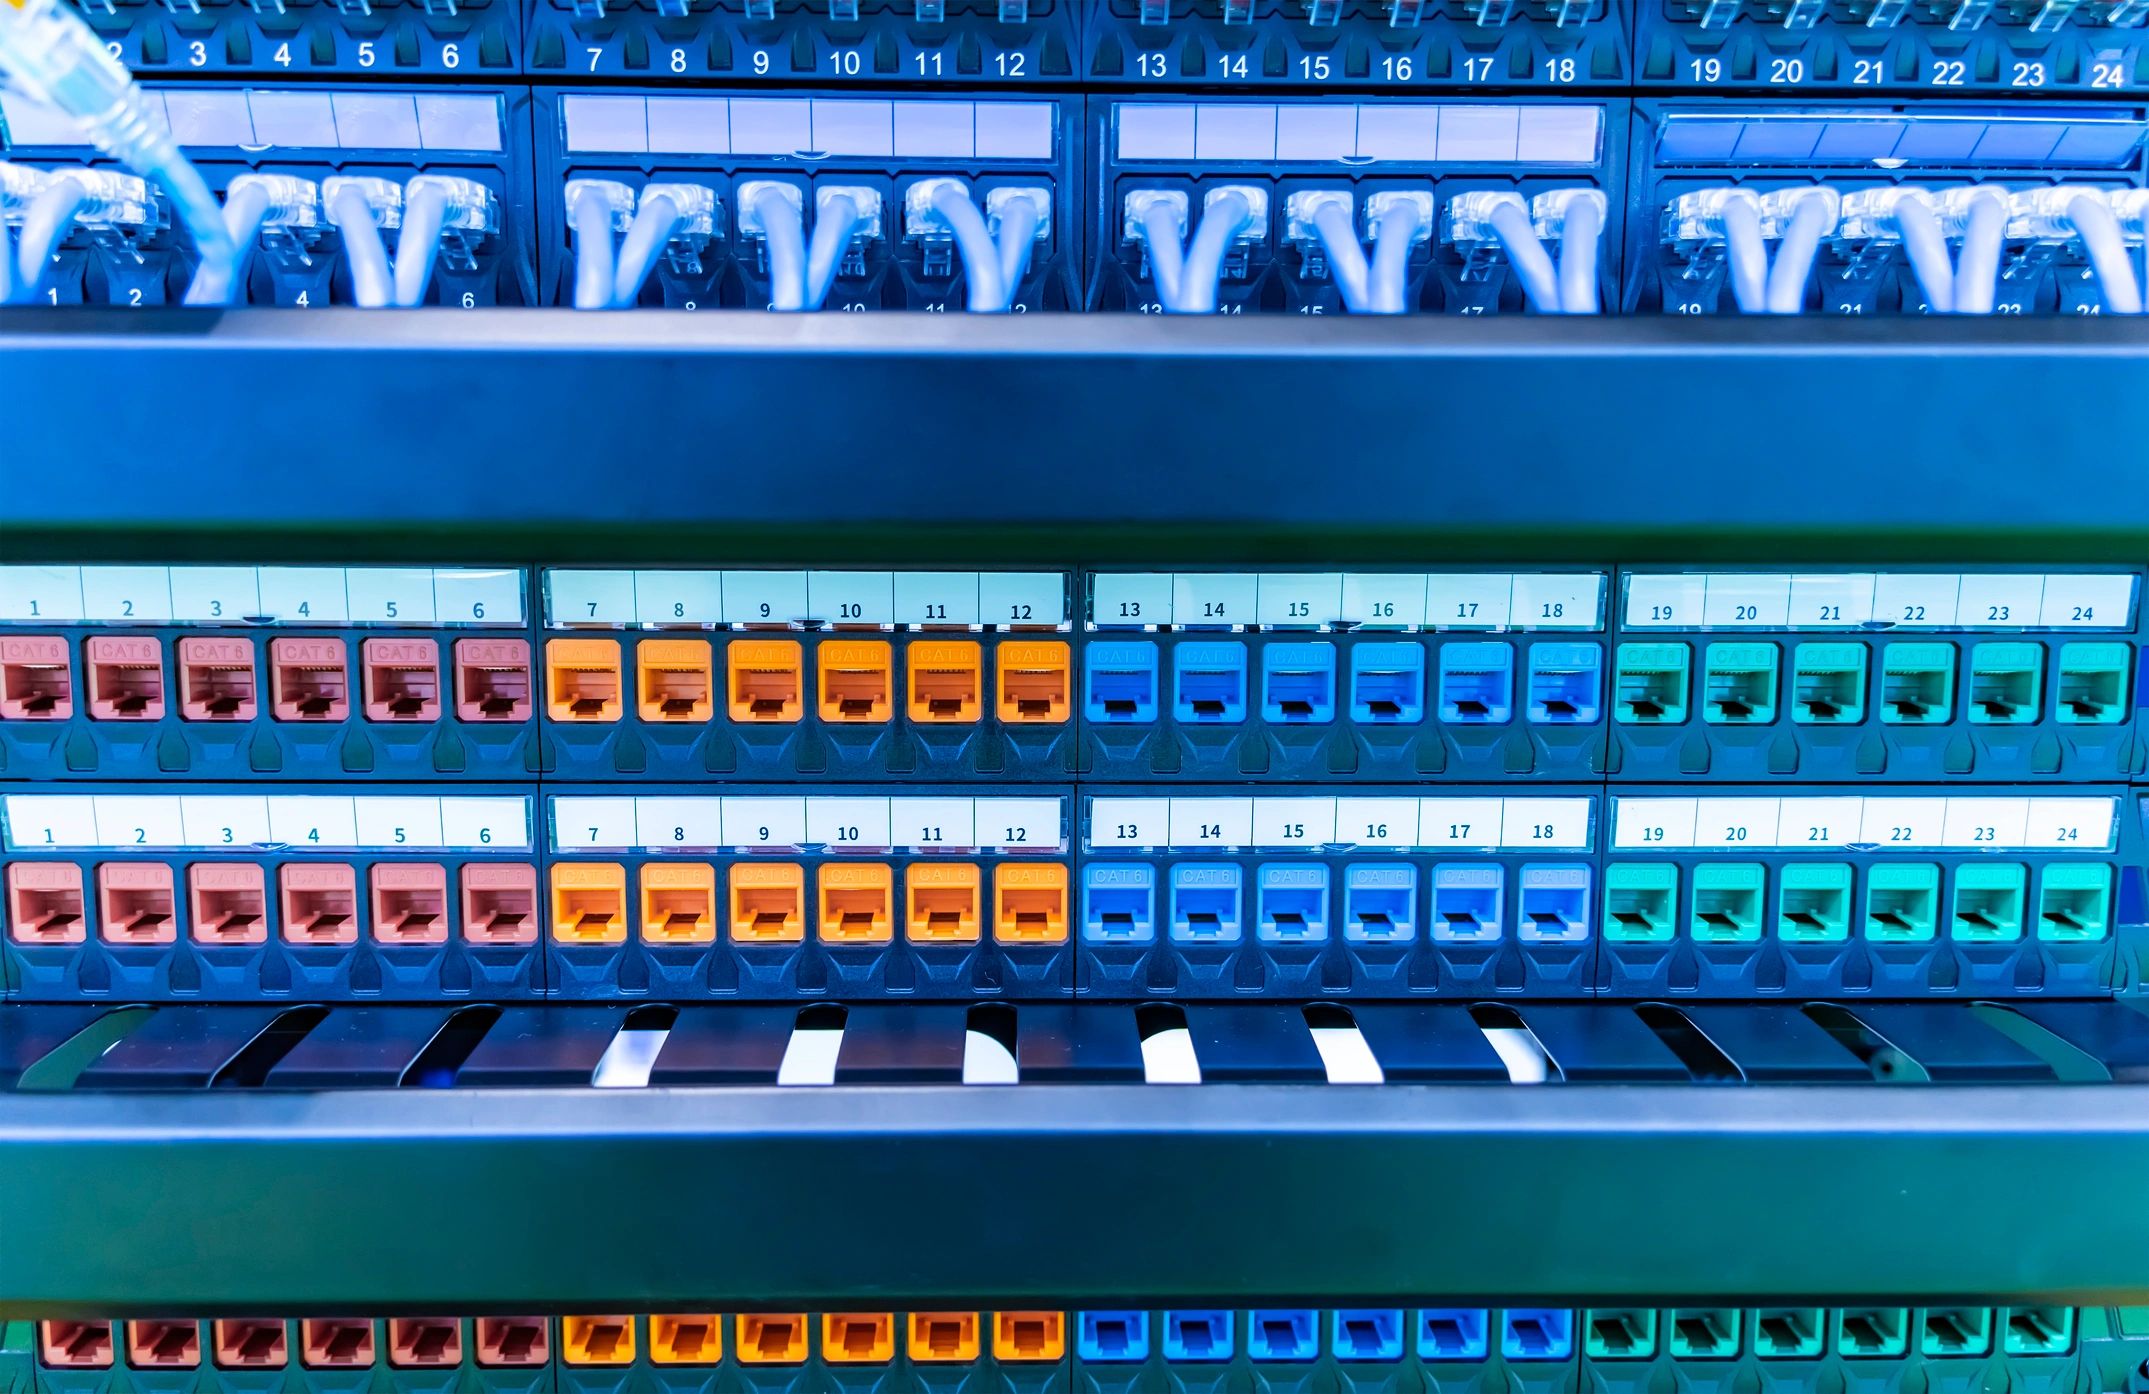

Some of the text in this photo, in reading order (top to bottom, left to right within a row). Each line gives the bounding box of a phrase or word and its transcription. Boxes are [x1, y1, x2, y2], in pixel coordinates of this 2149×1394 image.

[106, 41, 123, 66] 2
[190, 40, 207, 67] 3
[273, 42, 292, 67] 4
[358, 42, 375, 67] 5
[442, 43, 460, 69] 6
[587, 47, 603, 72] 7
[670, 48, 687, 73] 8
[753, 50, 769, 75] 9
[830, 50, 861, 75] 10
[915, 52, 942, 76] 11
[995, 52, 1025, 77] 12
[1136, 53, 1167, 78] 13
[1218, 54, 1249, 79] 14
[1299, 55, 1330, 80] 15
[1382, 56, 1412, 81] 16
[1463, 57, 1494, 82] 17
[1545, 58, 1575, 83] 18
[1690, 58, 1721, 83] 19
[1770, 59, 1804, 83] 20
[1853, 59, 1883, 84] 21
[1931, 61, 1966, 86] 22
[2011, 62, 2046, 87] 23
[2091, 63, 2125, 88] 24
[48, 288, 58, 306] 1
[128, 288, 142, 306] 2
[296, 291, 309, 307] 4
[462, 292, 475, 309] 6
[30, 599, 41, 616] 1
[122, 600, 134, 617] 2
[210, 600, 222, 617] 3
[298, 601, 310, 618] 4
[386, 601, 398, 618] 5
[472, 602, 485, 619] 6
[587, 602, 597, 617] 7
[674, 602, 684, 618] 8
[760, 602, 771, 618] 9
[840, 603, 862, 619] 10
[925, 604, 947, 619] 11
[1010, 604, 1032, 620] 12
[1119, 602, 1141, 617] 13
[1203, 602, 1225, 617] 14
[1288, 602, 1309, 617] 15
[1372, 602, 1394, 617] 16
[1457, 603, 1479, 618] 17
[1542, 603, 1563, 618] 18
[1651, 605, 1673, 621] 19
[1735, 605, 1757, 620] 20
[1819, 605, 1841, 621] 21
[1903, 606, 1925, 621] 22
[1987, 606, 2009, 621] 23
[2071, 606, 2093, 621] 24
[9, 644, 59, 658] CAT 6
[102, 644, 152, 658] CAT 6
[193, 645, 244, 659] CAT 6
[285, 646, 336, 660] CAT 6
[376, 646, 427, 660] CAT 6
[469, 646, 519, 660] CAT 6
[830, 649, 879, 662] CAT 6
[920, 649, 969, 662] CAT 6
[1009, 649, 1058, 662] CAT 6
[44, 828, 55, 844] 1
[135, 828, 147, 844] 2
[222, 827, 233, 843] 3
[308, 828, 320, 843] 4
[394, 827, 406, 844] 5
[479, 827, 491, 844] 6
[588, 827, 599, 842] 7
[674, 826, 685, 841] 8
[759, 826, 769, 841] 9
[838, 826, 859, 841] 10
[922, 827, 943, 842] 11
[1005, 827, 1027, 842] 12
[1117, 824, 1138, 839] 13
[1200, 824, 1221, 839] 14
[1283, 824, 1304, 838] 15
[1366, 823, 1387, 838] 16
[1449, 824, 1471, 839] 17
[1532, 824, 1554, 839] 18
[1643, 827, 1664, 841] 19
[1725, 827, 1747, 841] 20
[1808, 827, 1829, 841] 21
[1890, 827, 1912, 841] 22
[1973, 827, 1995, 841] 23
[2056, 827, 2078, 842] 24
[653, 869, 687, 882] CAT
[741, 869, 790, 882] CAT 6
[830, 869, 879, 882] CAT 6
[919, 869, 966, 882] CAT 6
[1007, 869, 1055, 882] CAT 6
[1094, 869, 1143, 882] CAT 6
[1181, 869, 1230, 882] CAT 6
[1268, 869, 1317, 882] CAT 6
[1356, 869, 1404, 882] CAT 6
[1444, 869, 1490, 882] CAT 6
[1530, 869, 1579, 882] CAT 6
